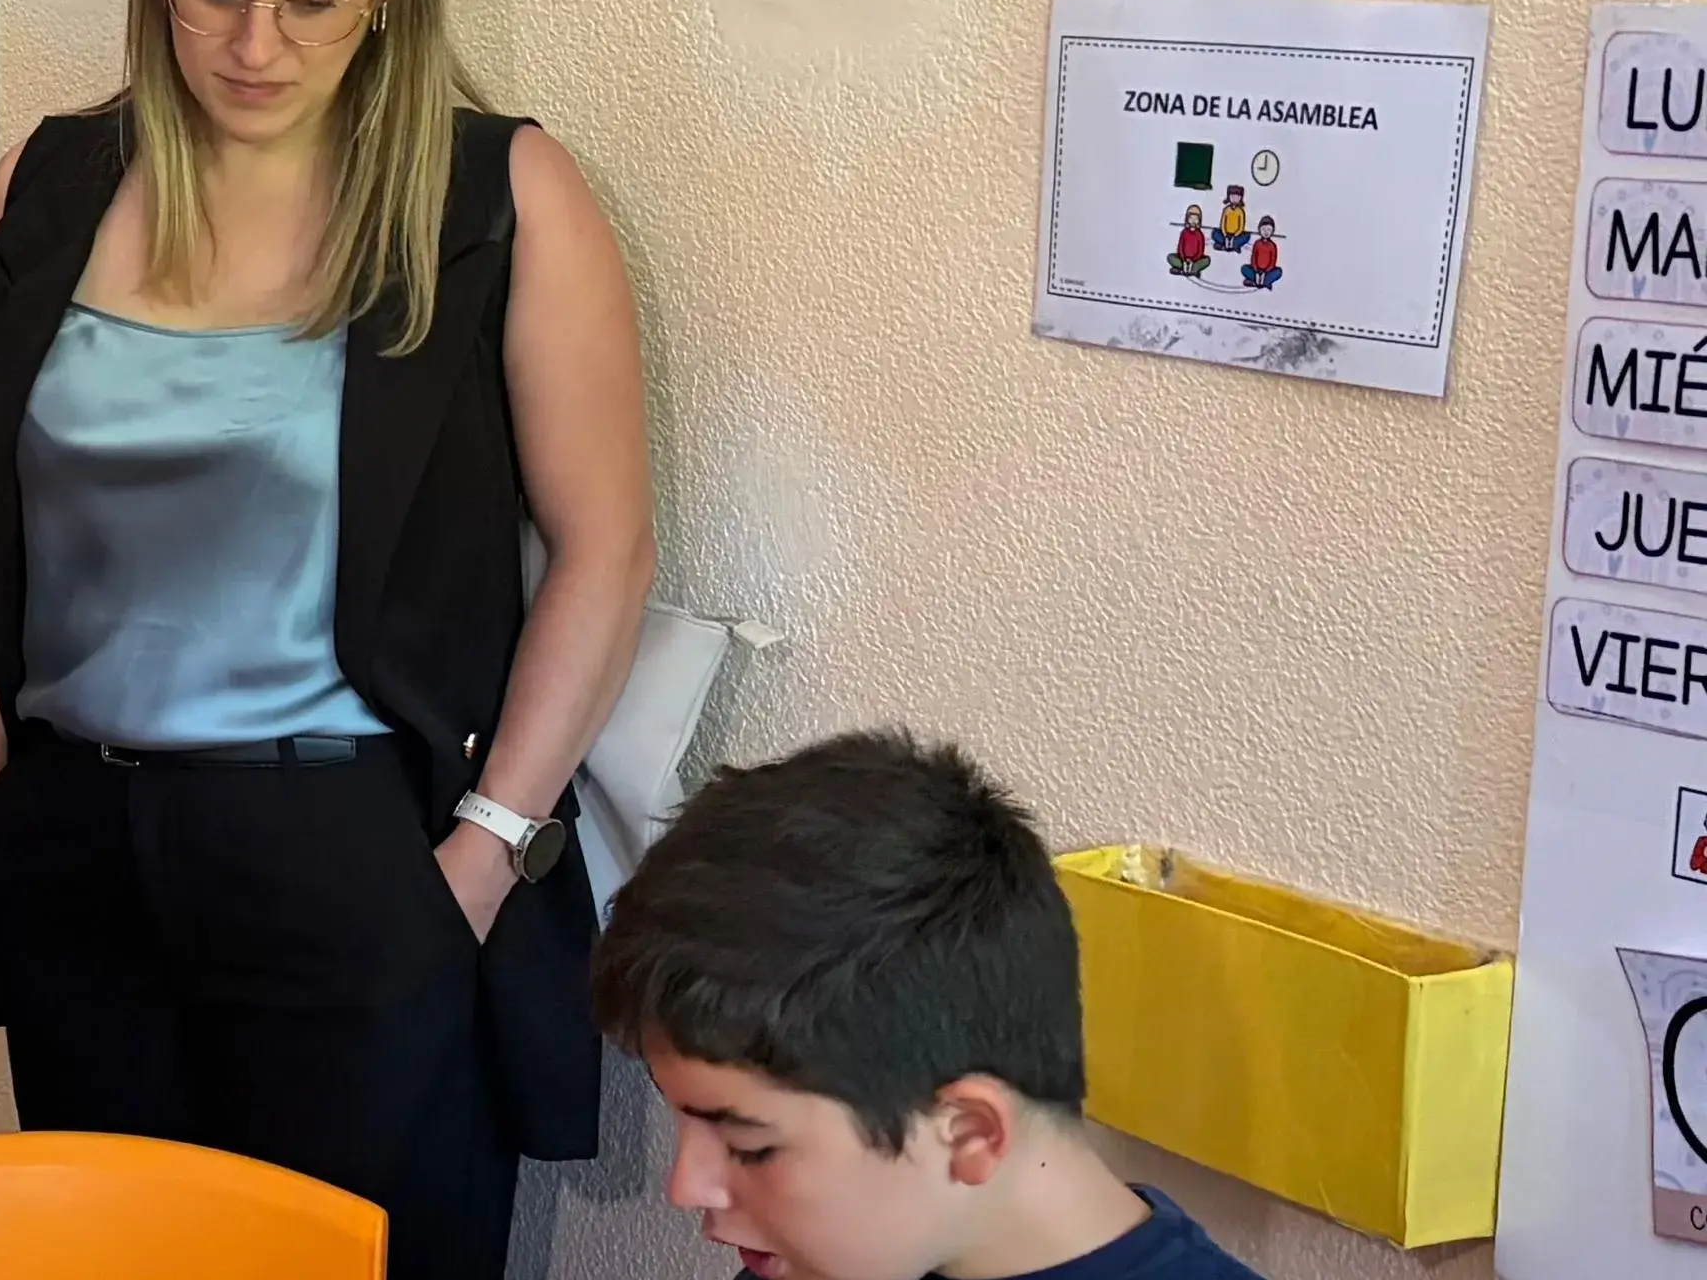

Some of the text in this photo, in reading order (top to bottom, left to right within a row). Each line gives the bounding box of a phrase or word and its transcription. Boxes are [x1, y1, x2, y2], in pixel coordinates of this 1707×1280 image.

[1123, 90, 1379, 131] ZONA DE LA ASAMBLEA
[1626, 66, 1705, 132] LU
